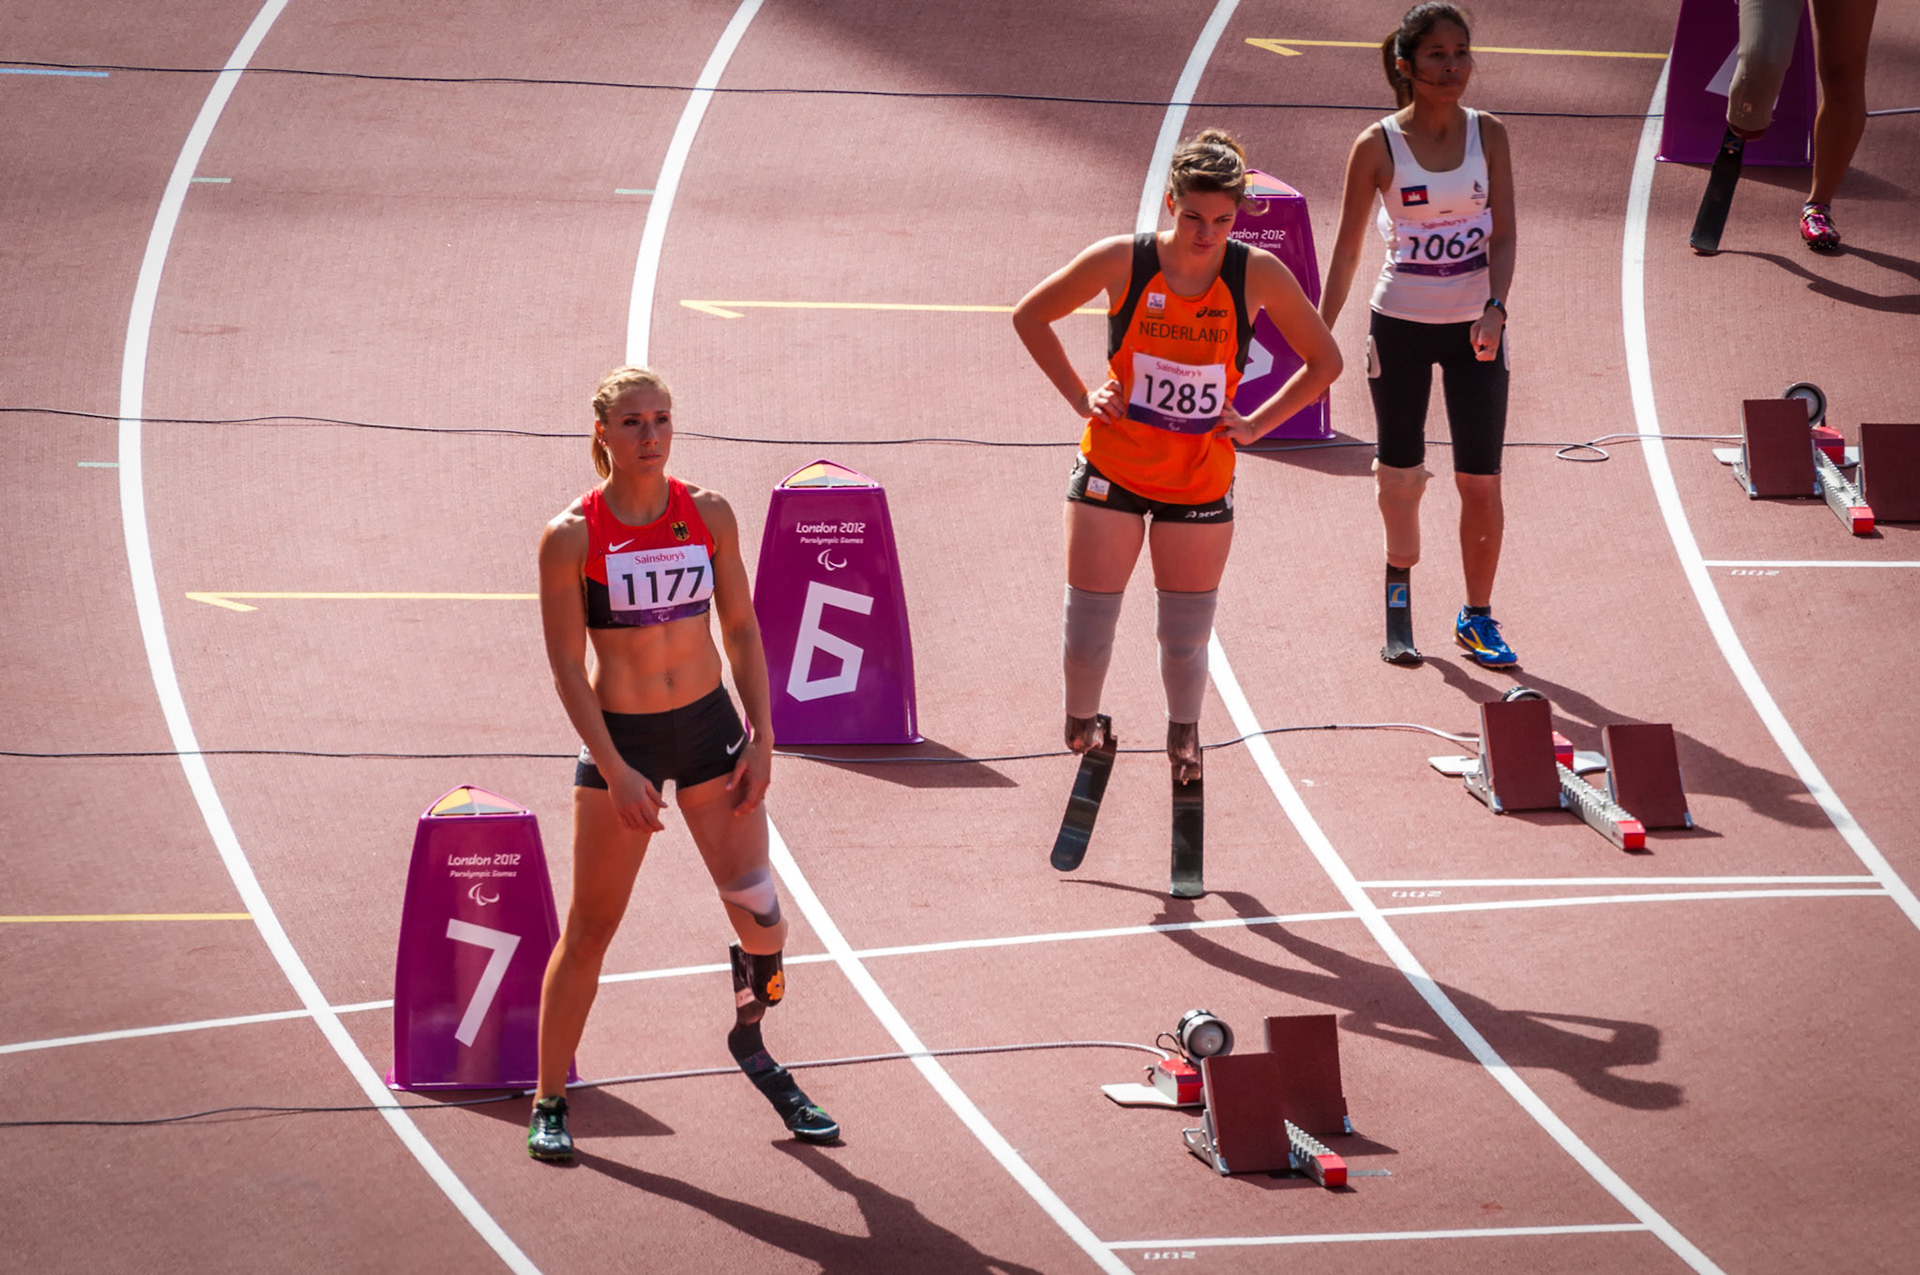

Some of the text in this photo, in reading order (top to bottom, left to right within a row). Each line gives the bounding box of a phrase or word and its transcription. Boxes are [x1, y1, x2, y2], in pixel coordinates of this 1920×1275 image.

[1261, 229, 1286, 240] 2012
[1408, 227, 1484, 261] 1062
[1139, 321, 1228, 343] NEDERLAND
[1155, 361, 1202, 378] Sainsbury's
[1144, 373, 1217, 415] 1285
[796, 521, 866, 534] London 2012
[800, 536, 839, 546] Paralympic
[634, 551, 686, 565] Sainsbury's
[622, 565, 705, 606] 1177
[786, 580, 875, 702] 6
[447, 853, 521, 867] London 2012
[449, 869, 517, 880] Paralympic Games
[445, 918, 522, 1048] 7
